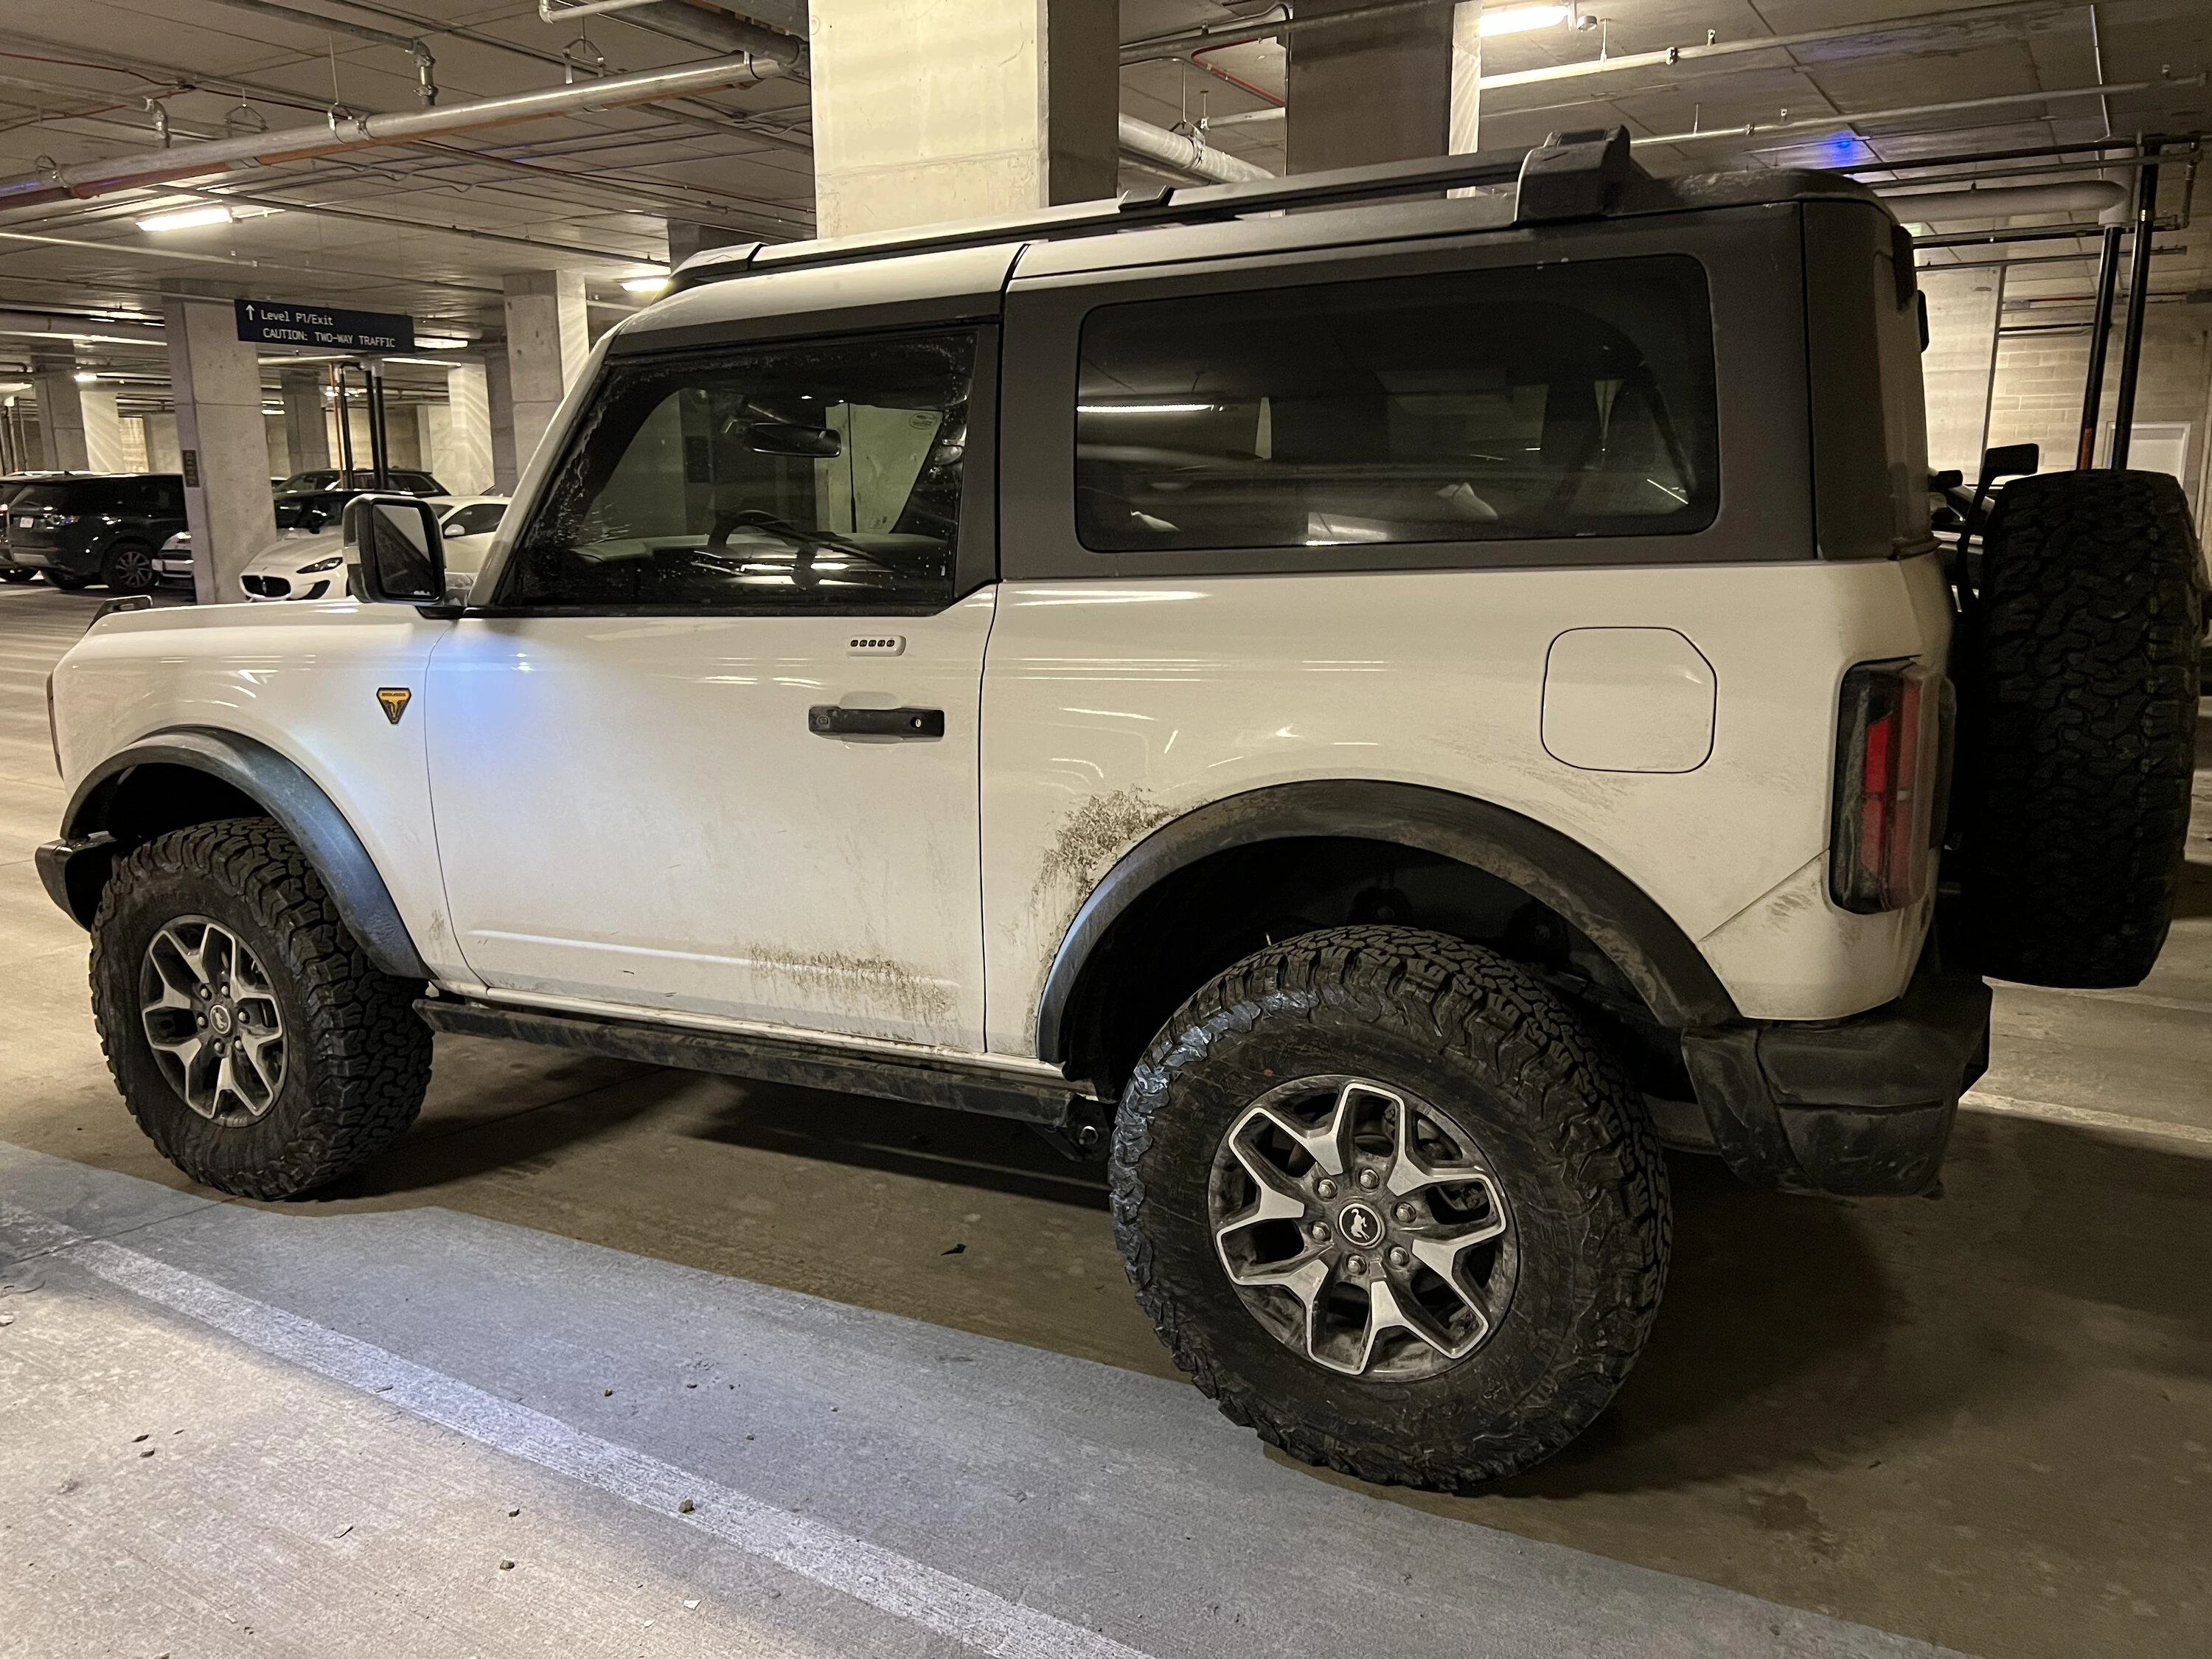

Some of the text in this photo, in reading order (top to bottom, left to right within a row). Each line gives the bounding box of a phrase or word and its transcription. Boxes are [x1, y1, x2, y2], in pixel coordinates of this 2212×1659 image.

[260, 309, 333, 325] Level P1/Exit
[262, 328, 396, 347] CAUTION: TWO-WAY TRAFFIC
